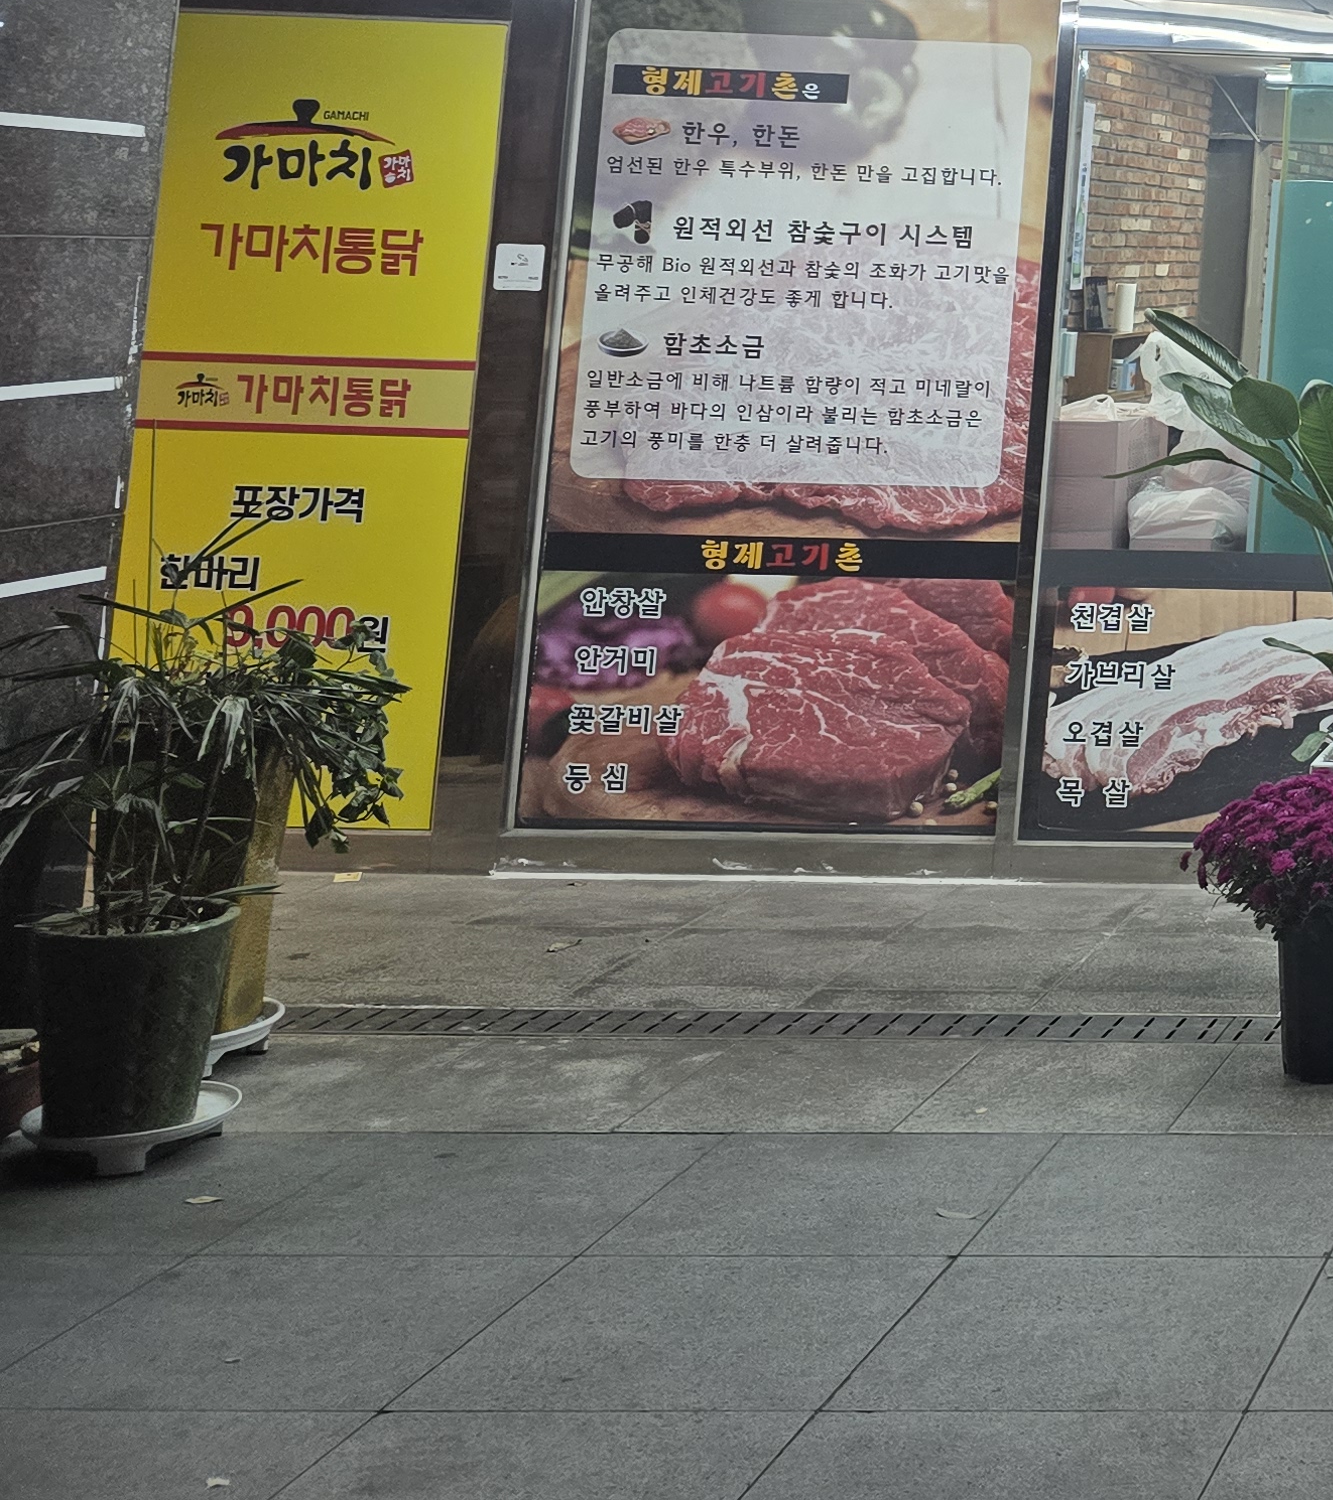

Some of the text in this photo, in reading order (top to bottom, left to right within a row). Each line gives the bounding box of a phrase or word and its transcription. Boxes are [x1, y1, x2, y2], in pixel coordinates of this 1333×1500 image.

[641, 65, 821, 101] 형제고기촌은
[323, 110, 370, 122] GAMACHI
[681, 120, 801, 149] 한우, 한돈
[223, 138, 373, 191] 가마치
[606, 155, 1002, 187] 엄선된 한우 특수부위, 한돈 만을 고집합니다.
[672, 216, 974, 250] 원적외선 참숯구이 시스템
[200, 222, 425, 278] 가마치통닭
[595, 253, 1010, 286] 무공해 Bio 원적외선과 참숯의 조화가 고기맛을
[593, 283, 672, 303] 올려주고
[681, 285, 777, 307] 인체건강도
[830, 289, 895, 311] 합니다.
[663, 332, 766, 360] 함초소금
[236, 373, 412, 419] 가마치통닭
[586, 369, 991, 399] 일반소금에 비해 나트륨 함량이 적고 미네랄이
[583, 399, 983, 429] 풍부하여 바다의 인삼이라 불리는 함초소금은
[579, 429, 889, 455] 고기의 풍미를 한층 더 살려줍니다.
[229, 484, 366, 524] 포장가격
[700, 538, 864, 573] 형제고기촌
[159, 552, 261, 592] 한마리
[579, 587, 667, 619] 안창살
[1070, 603, 1155, 633] 천겹살
[574, 645, 658, 677] 안거미
[1065, 661, 1177, 691] 가브리살
[568, 703, 684, 736] 꽃갈비살
[1061, 720, 1145, 748] 오겹살
